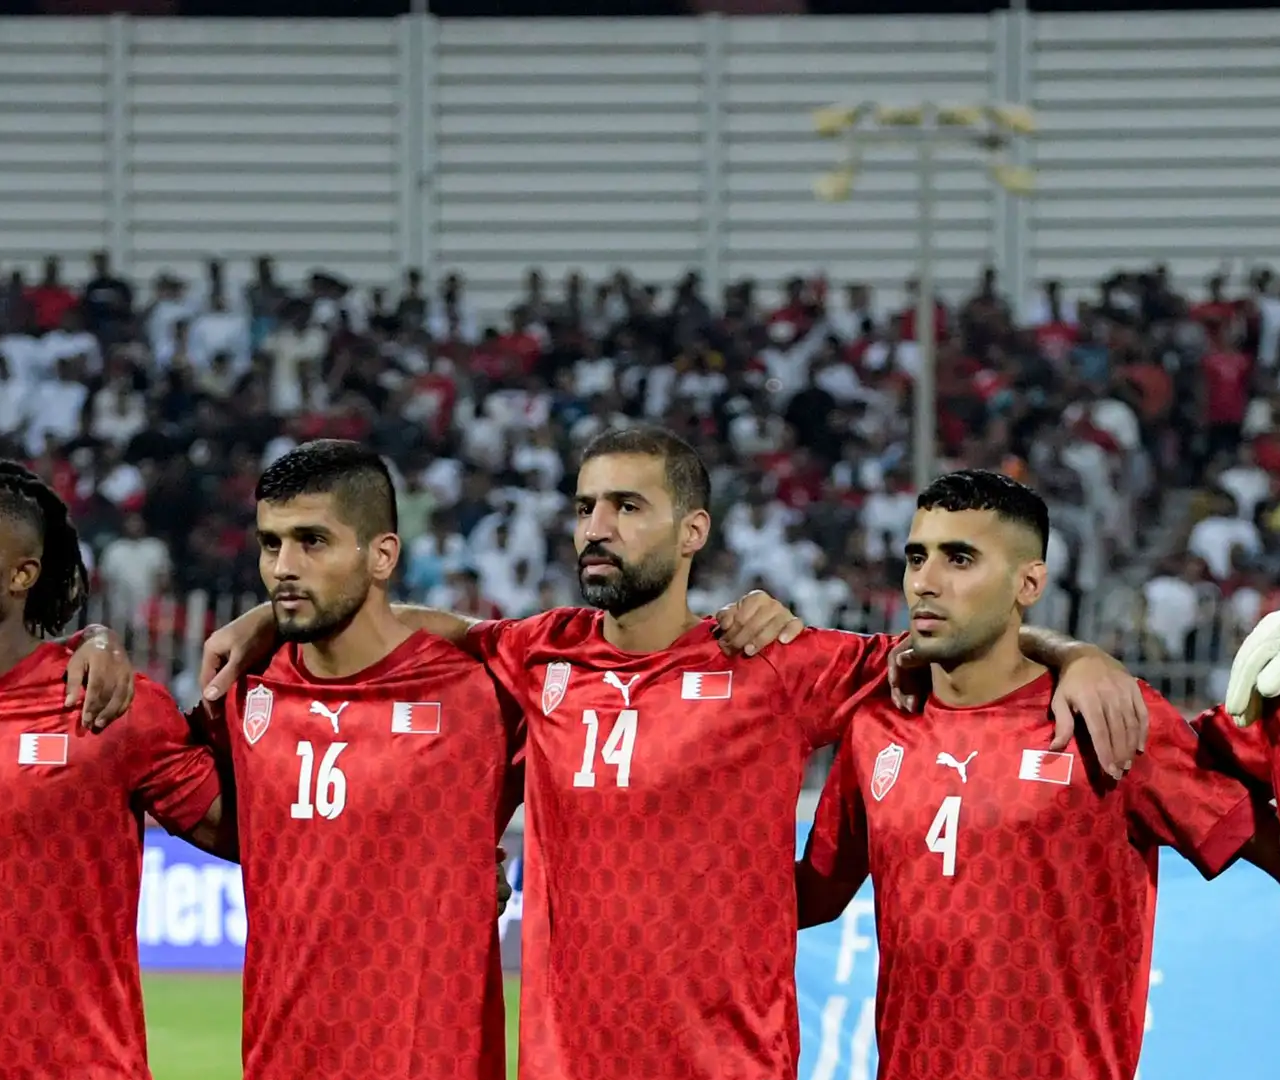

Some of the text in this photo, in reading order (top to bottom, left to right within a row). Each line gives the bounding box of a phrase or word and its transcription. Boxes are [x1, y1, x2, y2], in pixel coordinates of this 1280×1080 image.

[290, 740, 349, 820] 16
[573, 709, 638, 788] 14
[924, 795, 963, 877] 4
